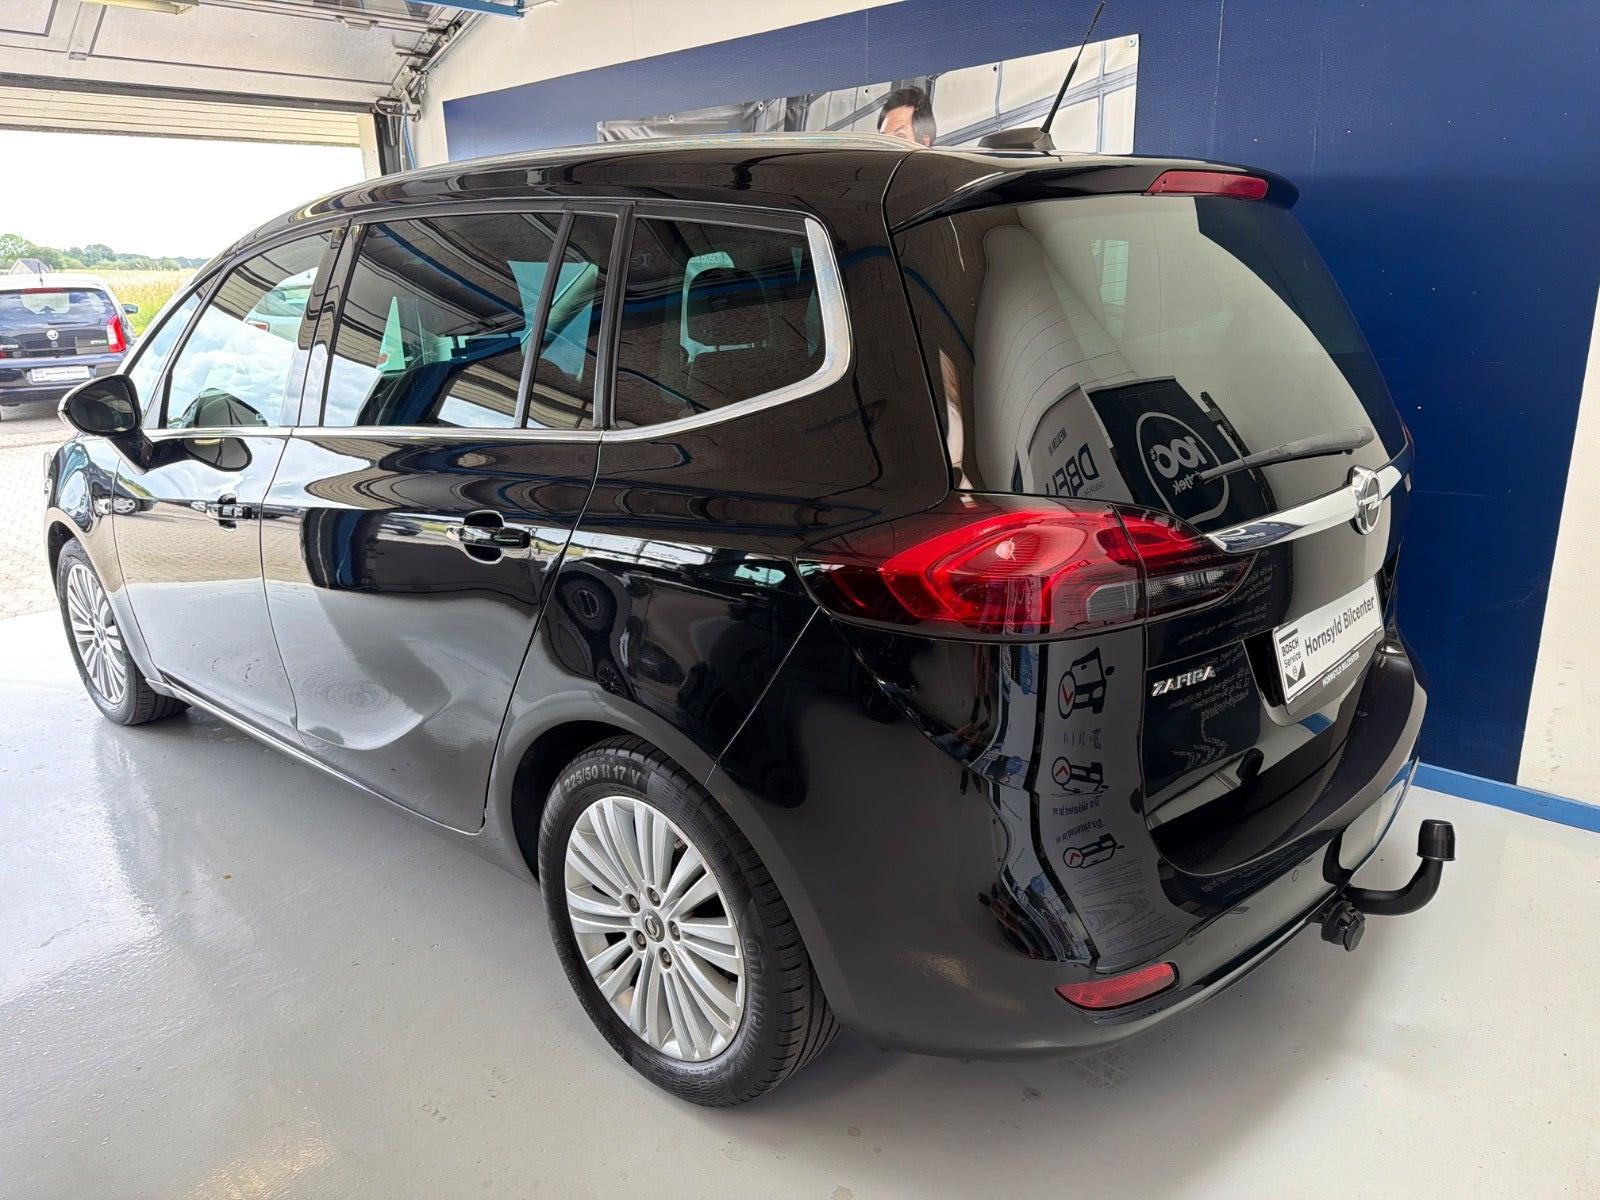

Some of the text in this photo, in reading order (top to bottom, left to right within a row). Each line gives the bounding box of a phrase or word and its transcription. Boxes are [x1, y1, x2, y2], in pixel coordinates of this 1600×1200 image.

[1304, 616, 1342, 657] Hornsyld
[1342, 596, 1375, 630] Bilcenter
[1281, 636, 1300, 658] BOSCH
[1283, 651, 1302, 669] Service
[1152, 665, 1217, 697] ZAFIRA
[564, 764, 599, 793] 225/50
[612, 764, 627, 780] 17
[631, 769, 642, 785] V
